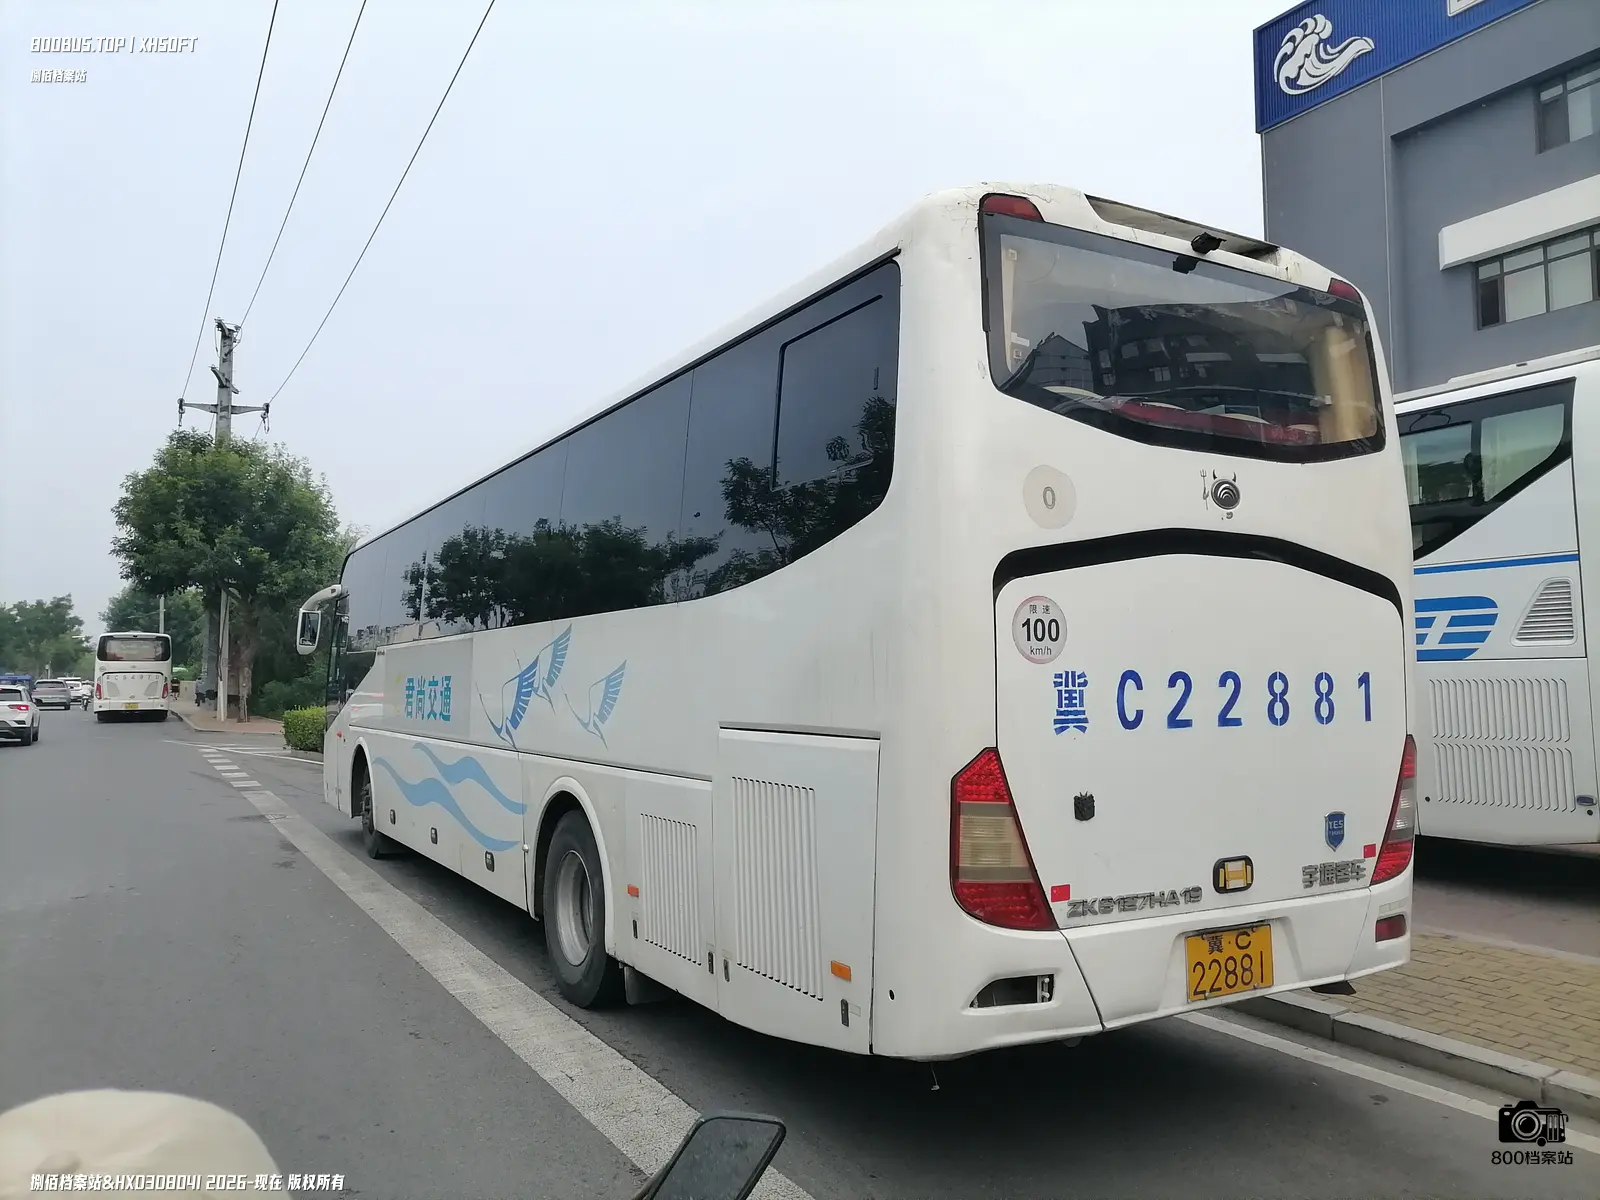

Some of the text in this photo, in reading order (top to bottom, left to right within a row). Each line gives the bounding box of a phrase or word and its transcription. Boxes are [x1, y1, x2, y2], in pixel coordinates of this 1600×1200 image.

[1029, 604, 1051, 614] 限速
[1021, 617, 1060, 643] 100
[1029, 645, 1052, 656] km/h
[405, 675, 452, 722] 君尚交通
[1301, 858, 1367, 889] 宇通客车
[1192, 950, 1264, 997] 22881
